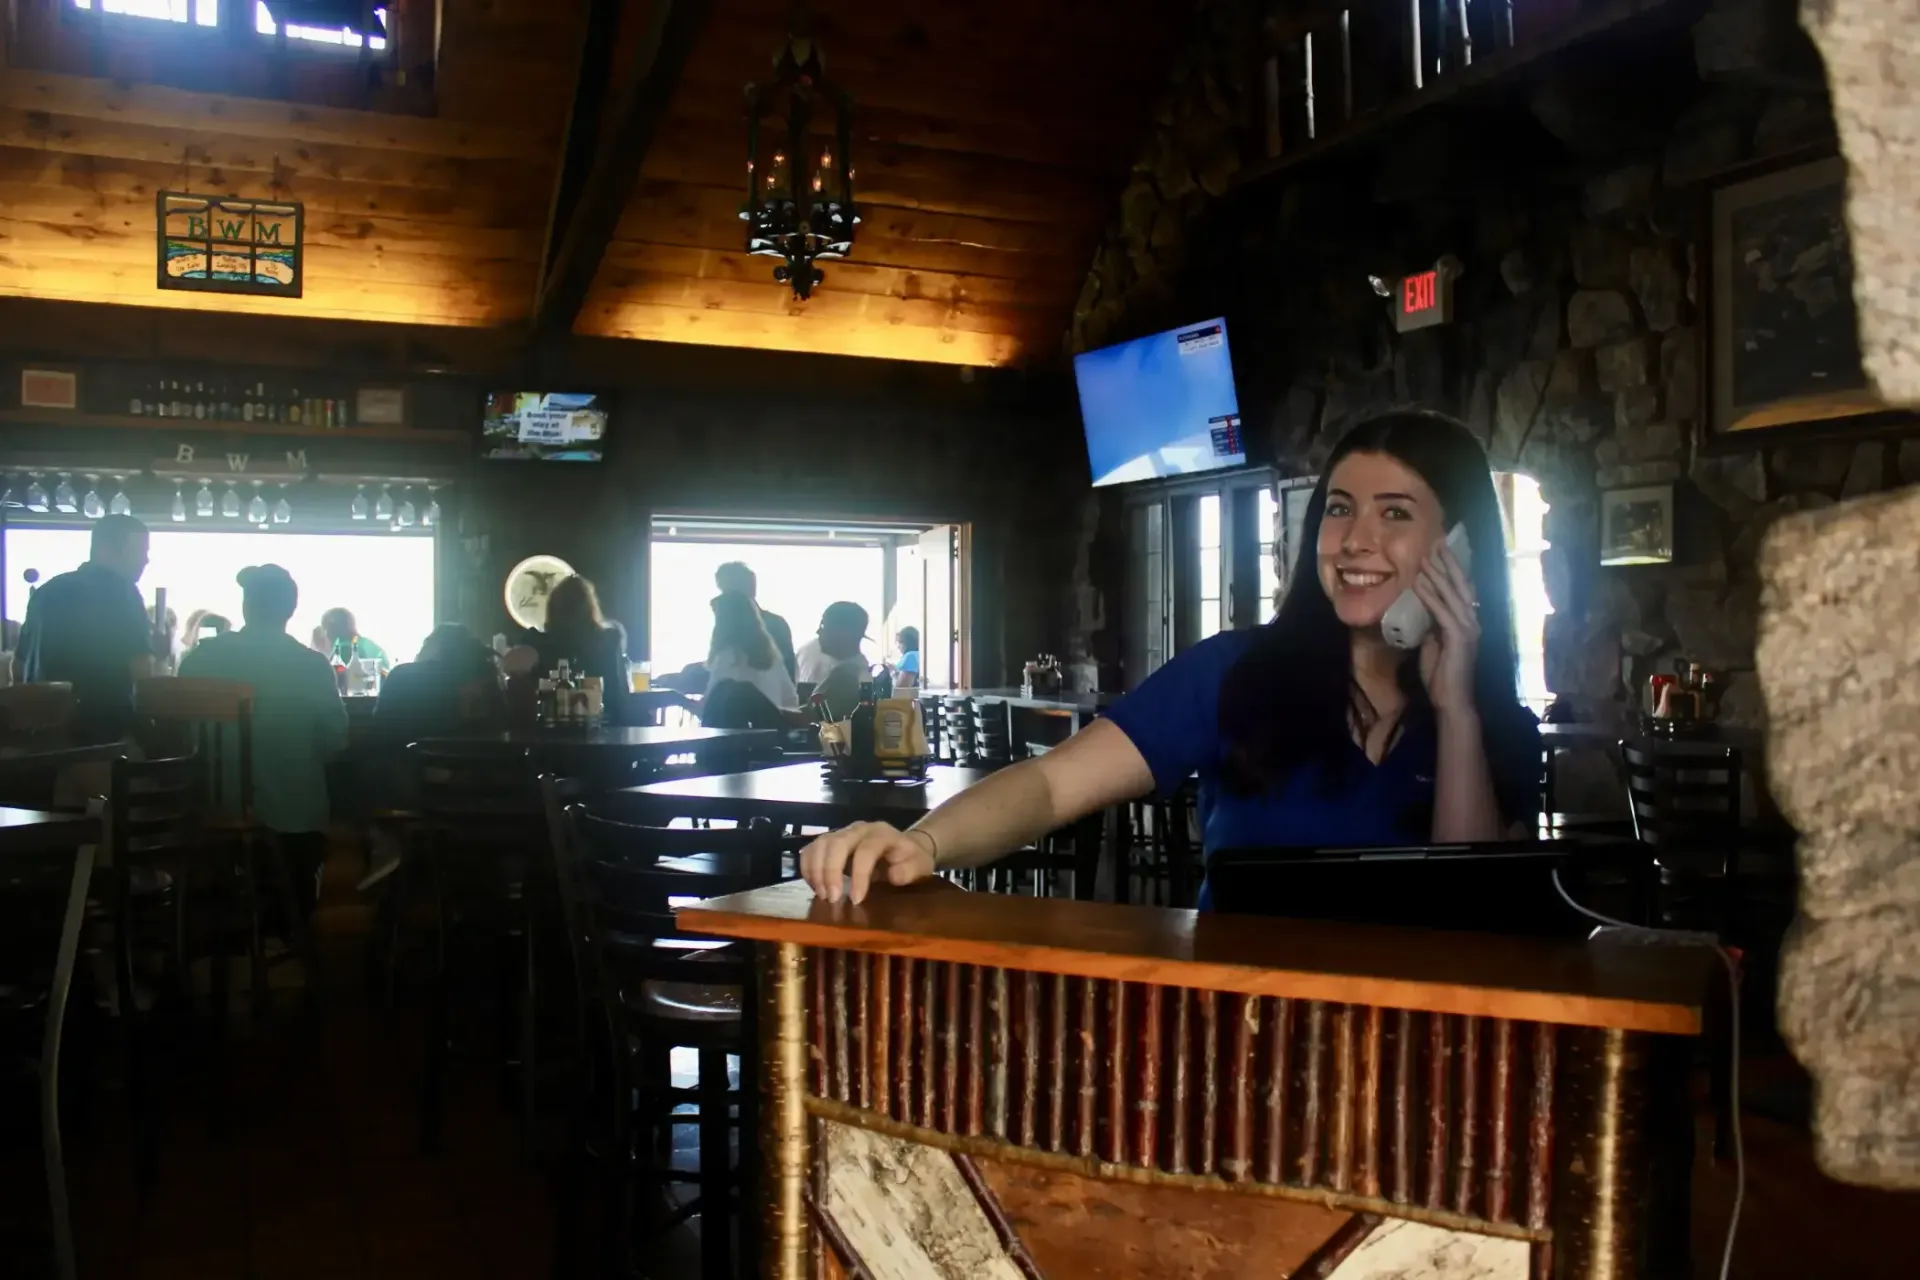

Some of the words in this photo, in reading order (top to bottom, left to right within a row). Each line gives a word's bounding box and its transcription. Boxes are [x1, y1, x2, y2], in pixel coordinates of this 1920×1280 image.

[188, 215, 208, 238] B
[217, 219, 245, 241] W
[256, 221, 281, 245] M
[1404, 271, 1437, 313] EXIT
[176, 443, 194, 464] B
[226, 452, 250, 472] W
[286, 449, 308, 468] M
